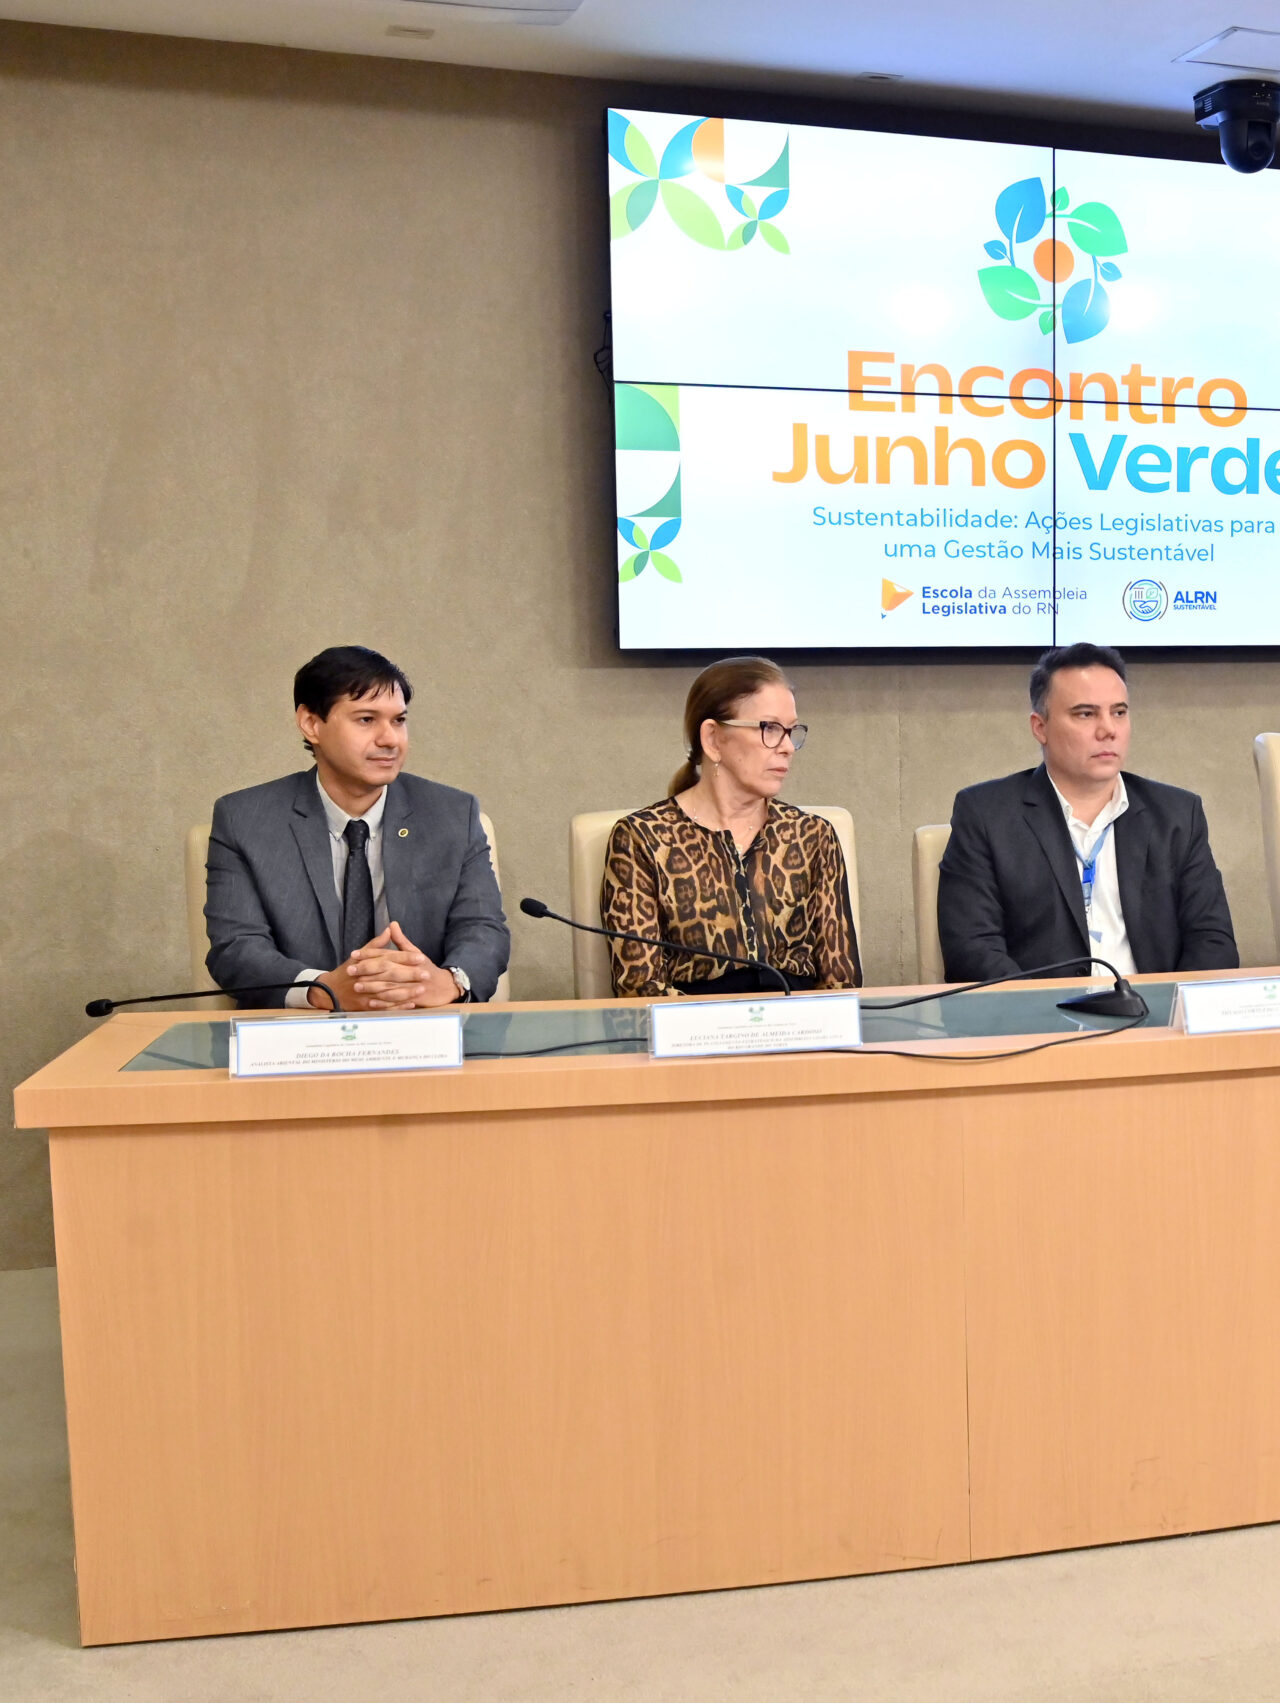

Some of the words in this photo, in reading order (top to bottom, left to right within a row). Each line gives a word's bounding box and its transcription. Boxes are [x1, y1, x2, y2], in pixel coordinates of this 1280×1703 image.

[847, 350, 1248, 428] Encontro
[772, 423, 1046, 489] Junho
[812, 506, 1019, 529] Sustentabilidade:
[1024, 510, 1093, 535] Ações
[1100, 512, 1224, 537] Legislativas
[1230, 518, 1276, 537] para
[884, 542, 936, 558] uma
[944, 539, 1024, 559] Gestão
[1031, 541, 1082, 560] Mais
[1089, 541, 1215, 561] Sustentável
[921, 586, 973, 599] Escola
[978, 586, 997, 599] da
[1002, 586, 1088, 600] Assembleia
[1173, 590, 1217, 604] ALRN
[921, 602, 1007, 617] Legislativa
[1012, 603, 1031, 615] do
[1037, 603, 1059, 615] RN
